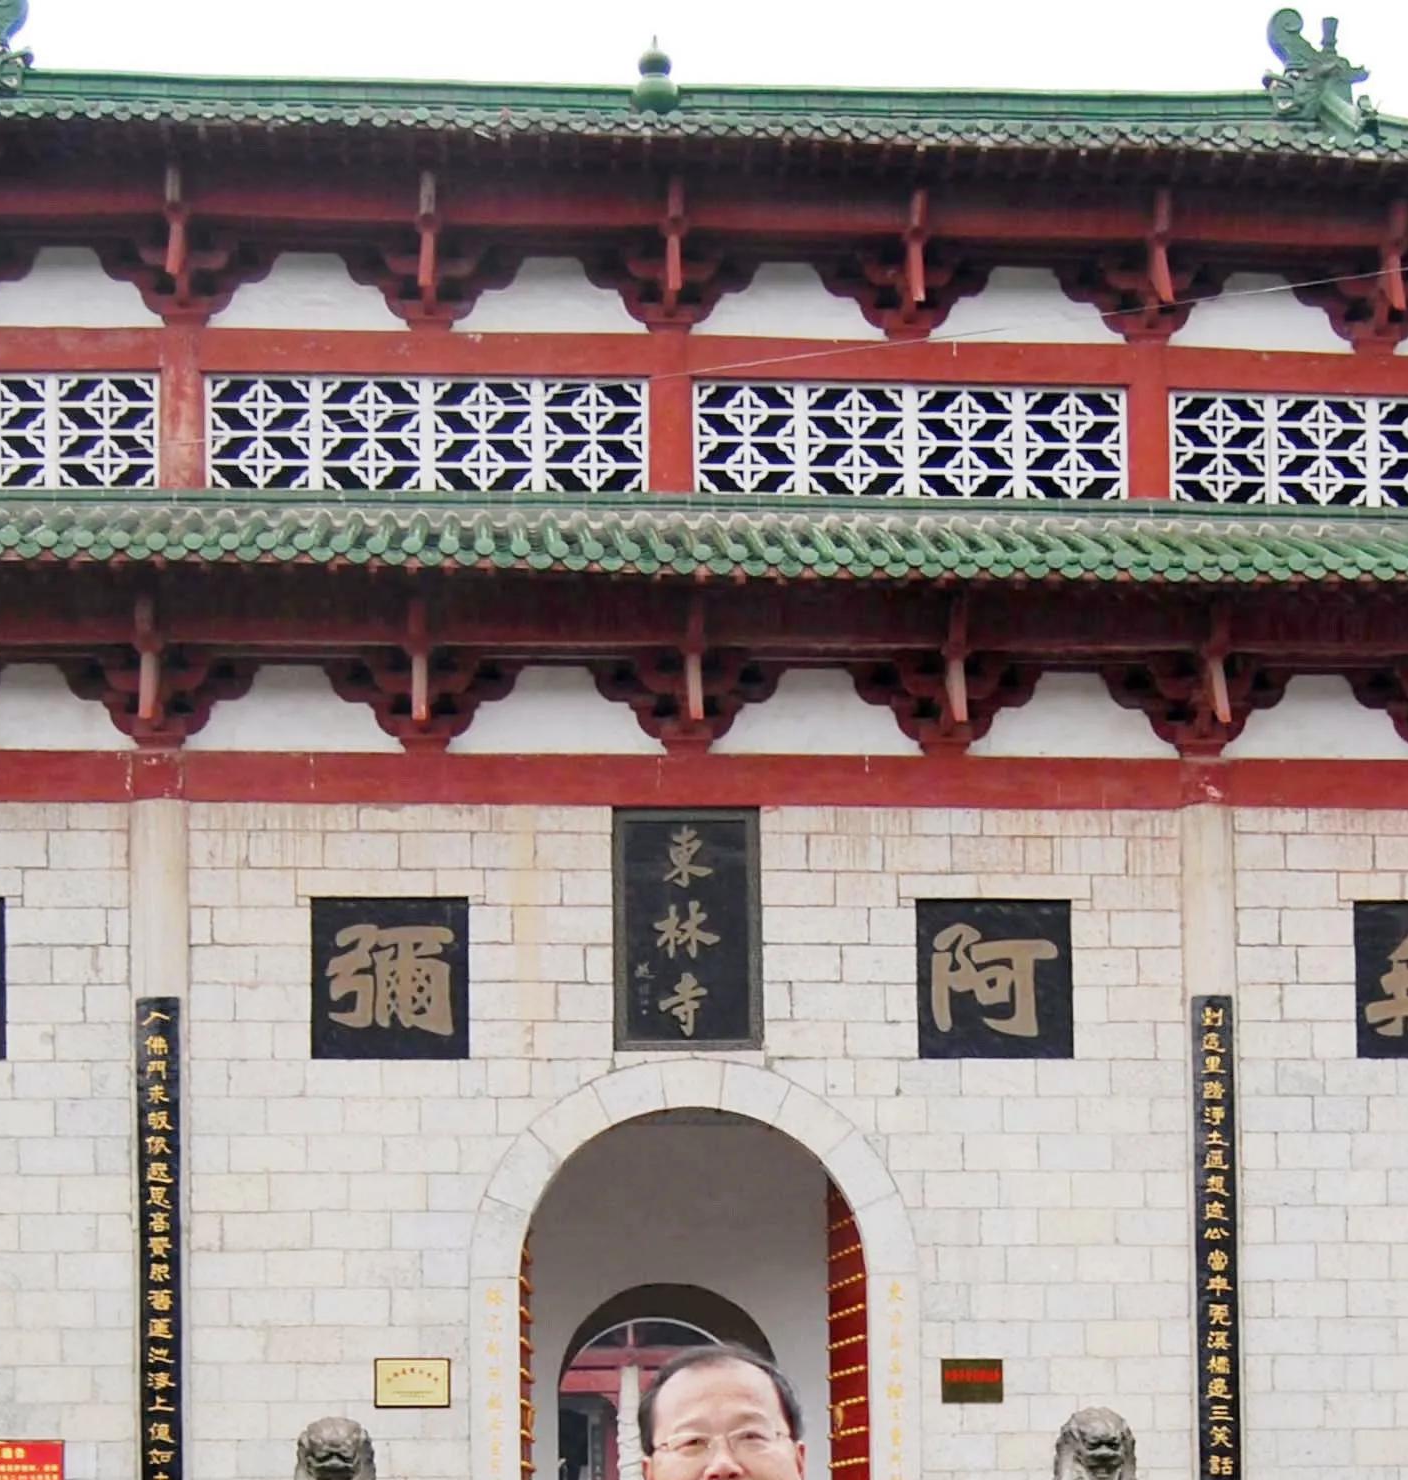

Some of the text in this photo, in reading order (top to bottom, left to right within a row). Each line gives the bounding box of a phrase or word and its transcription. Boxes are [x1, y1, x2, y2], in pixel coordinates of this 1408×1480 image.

[325, 923, 455, 1036] 彌
[652, 824, 722, 1038] 東林寺
[931, 922, 1058, 1037] 阿
